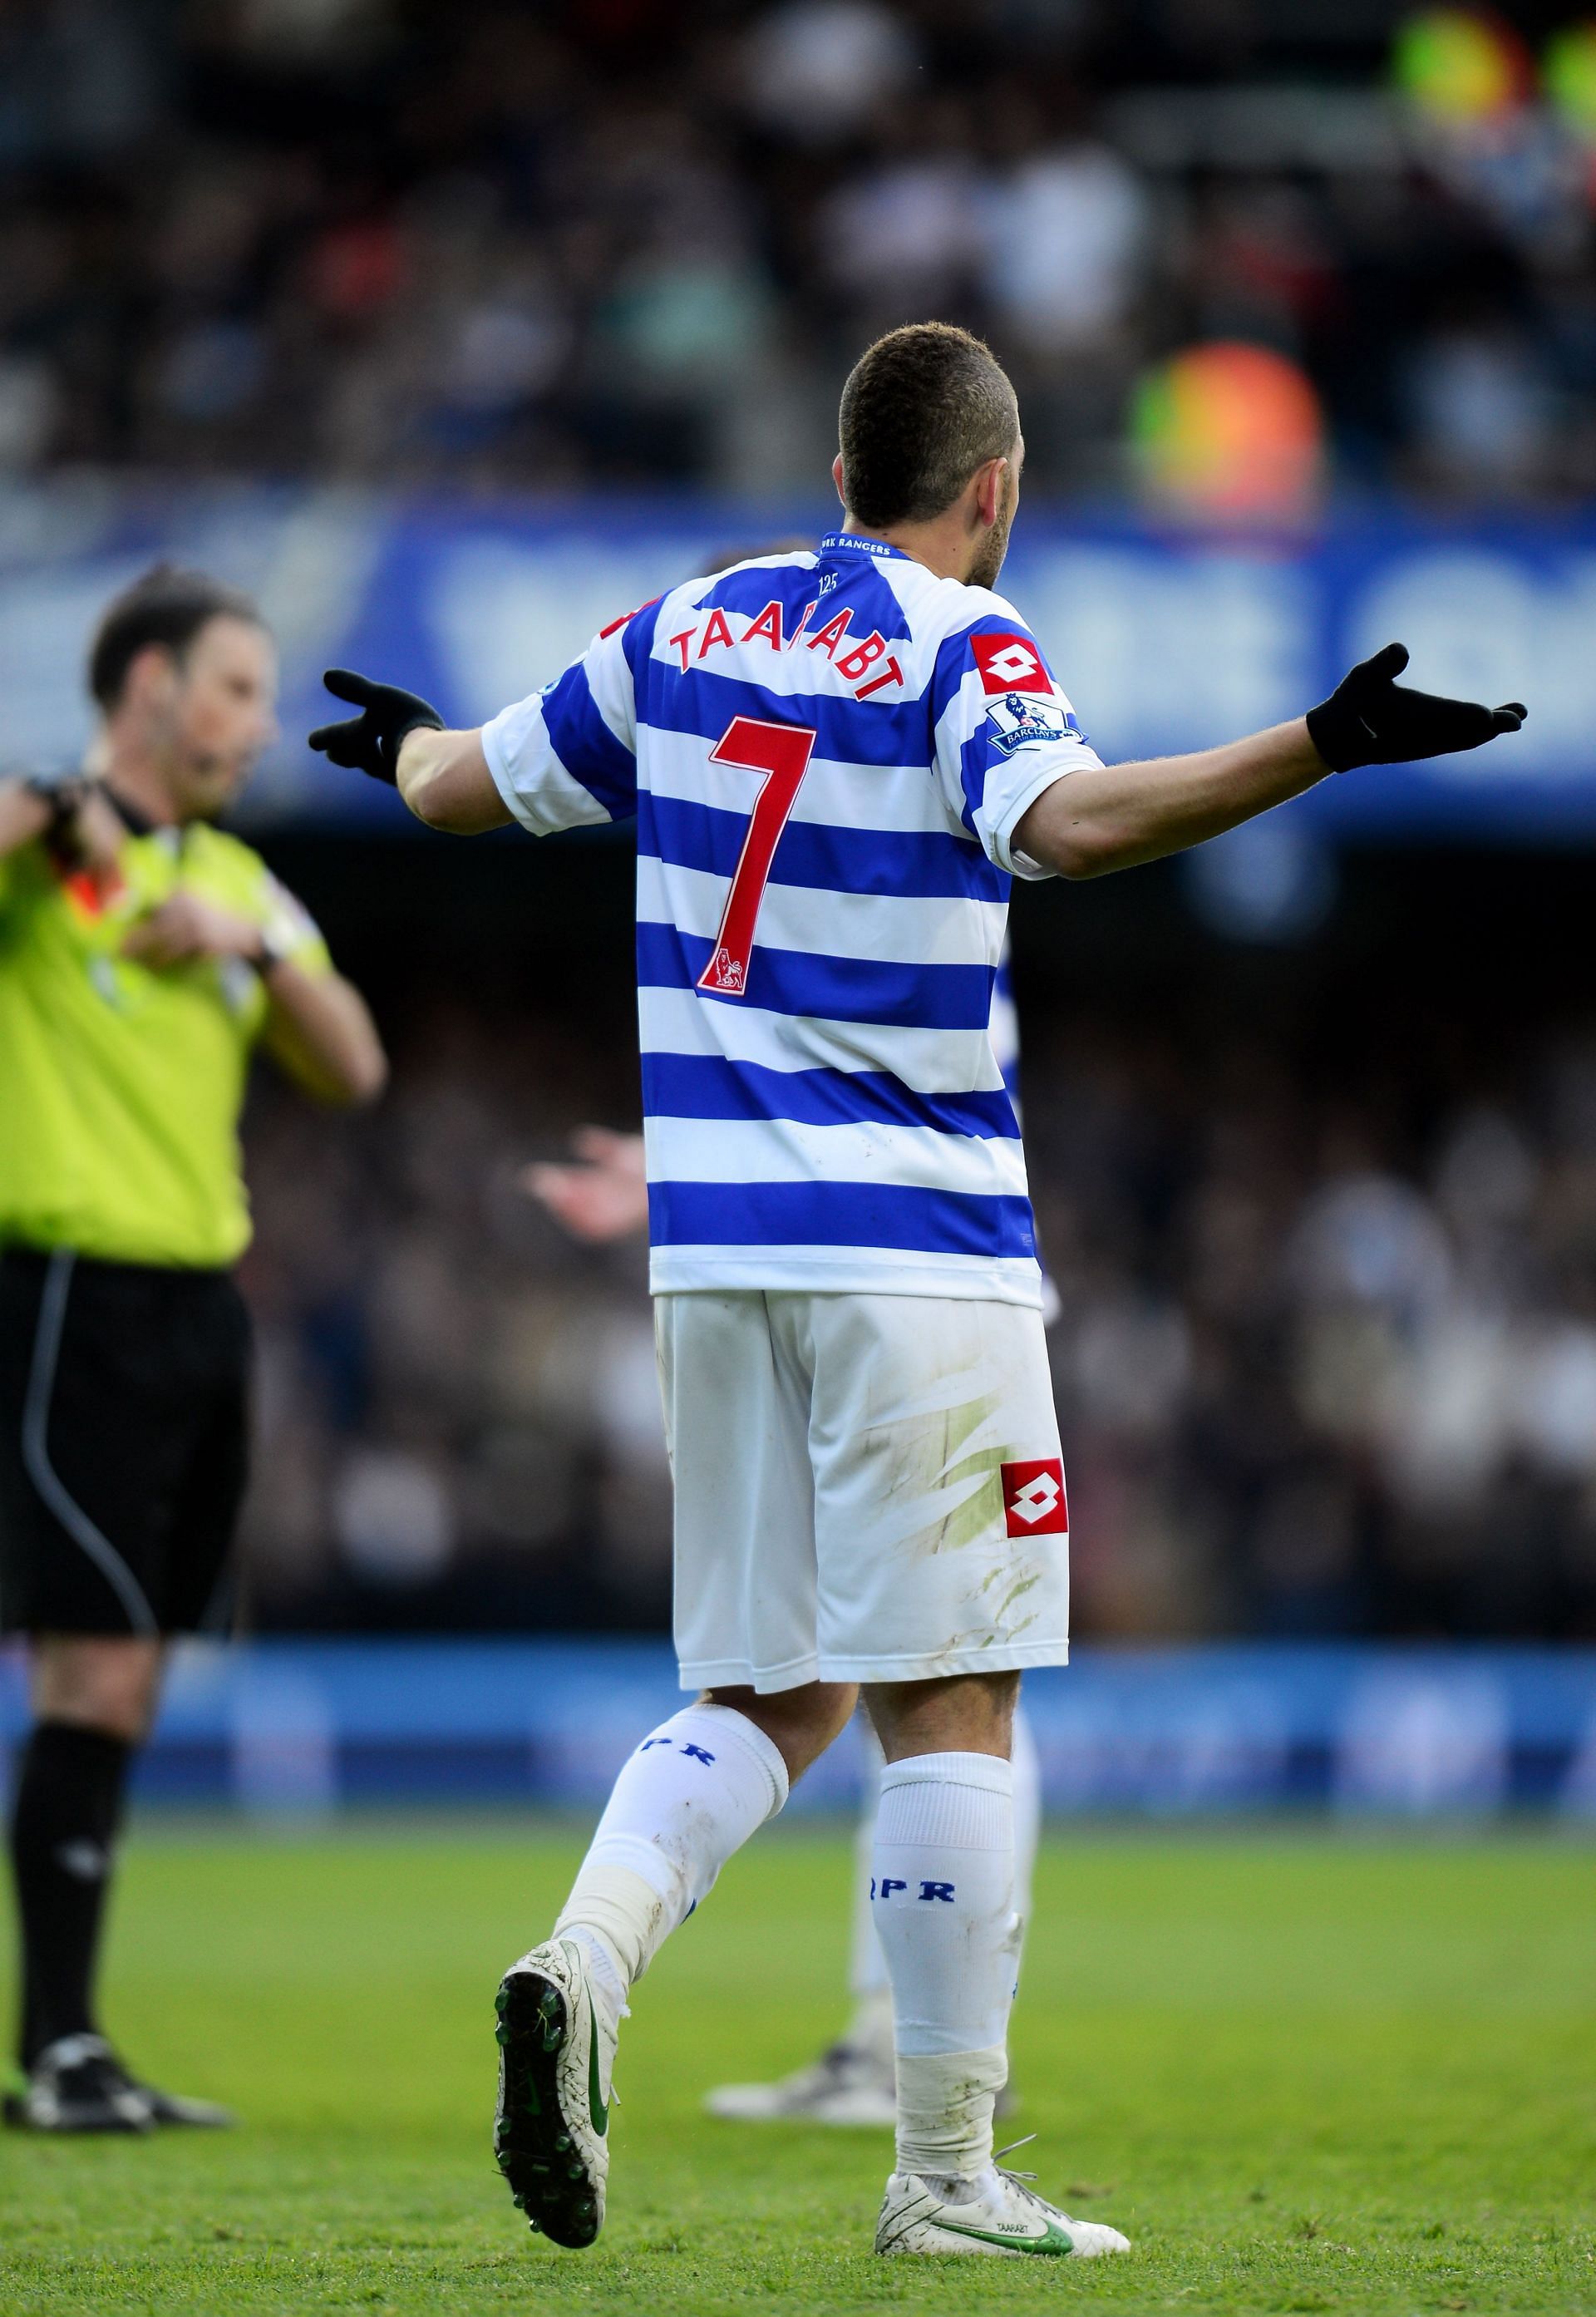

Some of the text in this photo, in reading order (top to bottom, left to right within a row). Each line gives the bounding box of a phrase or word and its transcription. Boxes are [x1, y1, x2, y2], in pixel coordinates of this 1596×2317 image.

[838, 538, 891, 555] RANGERS
[819, 572, 839, 597] 125
[1007, 727, 1057, 745] BARCLAYS
[696, 714, 817, 996] 7
